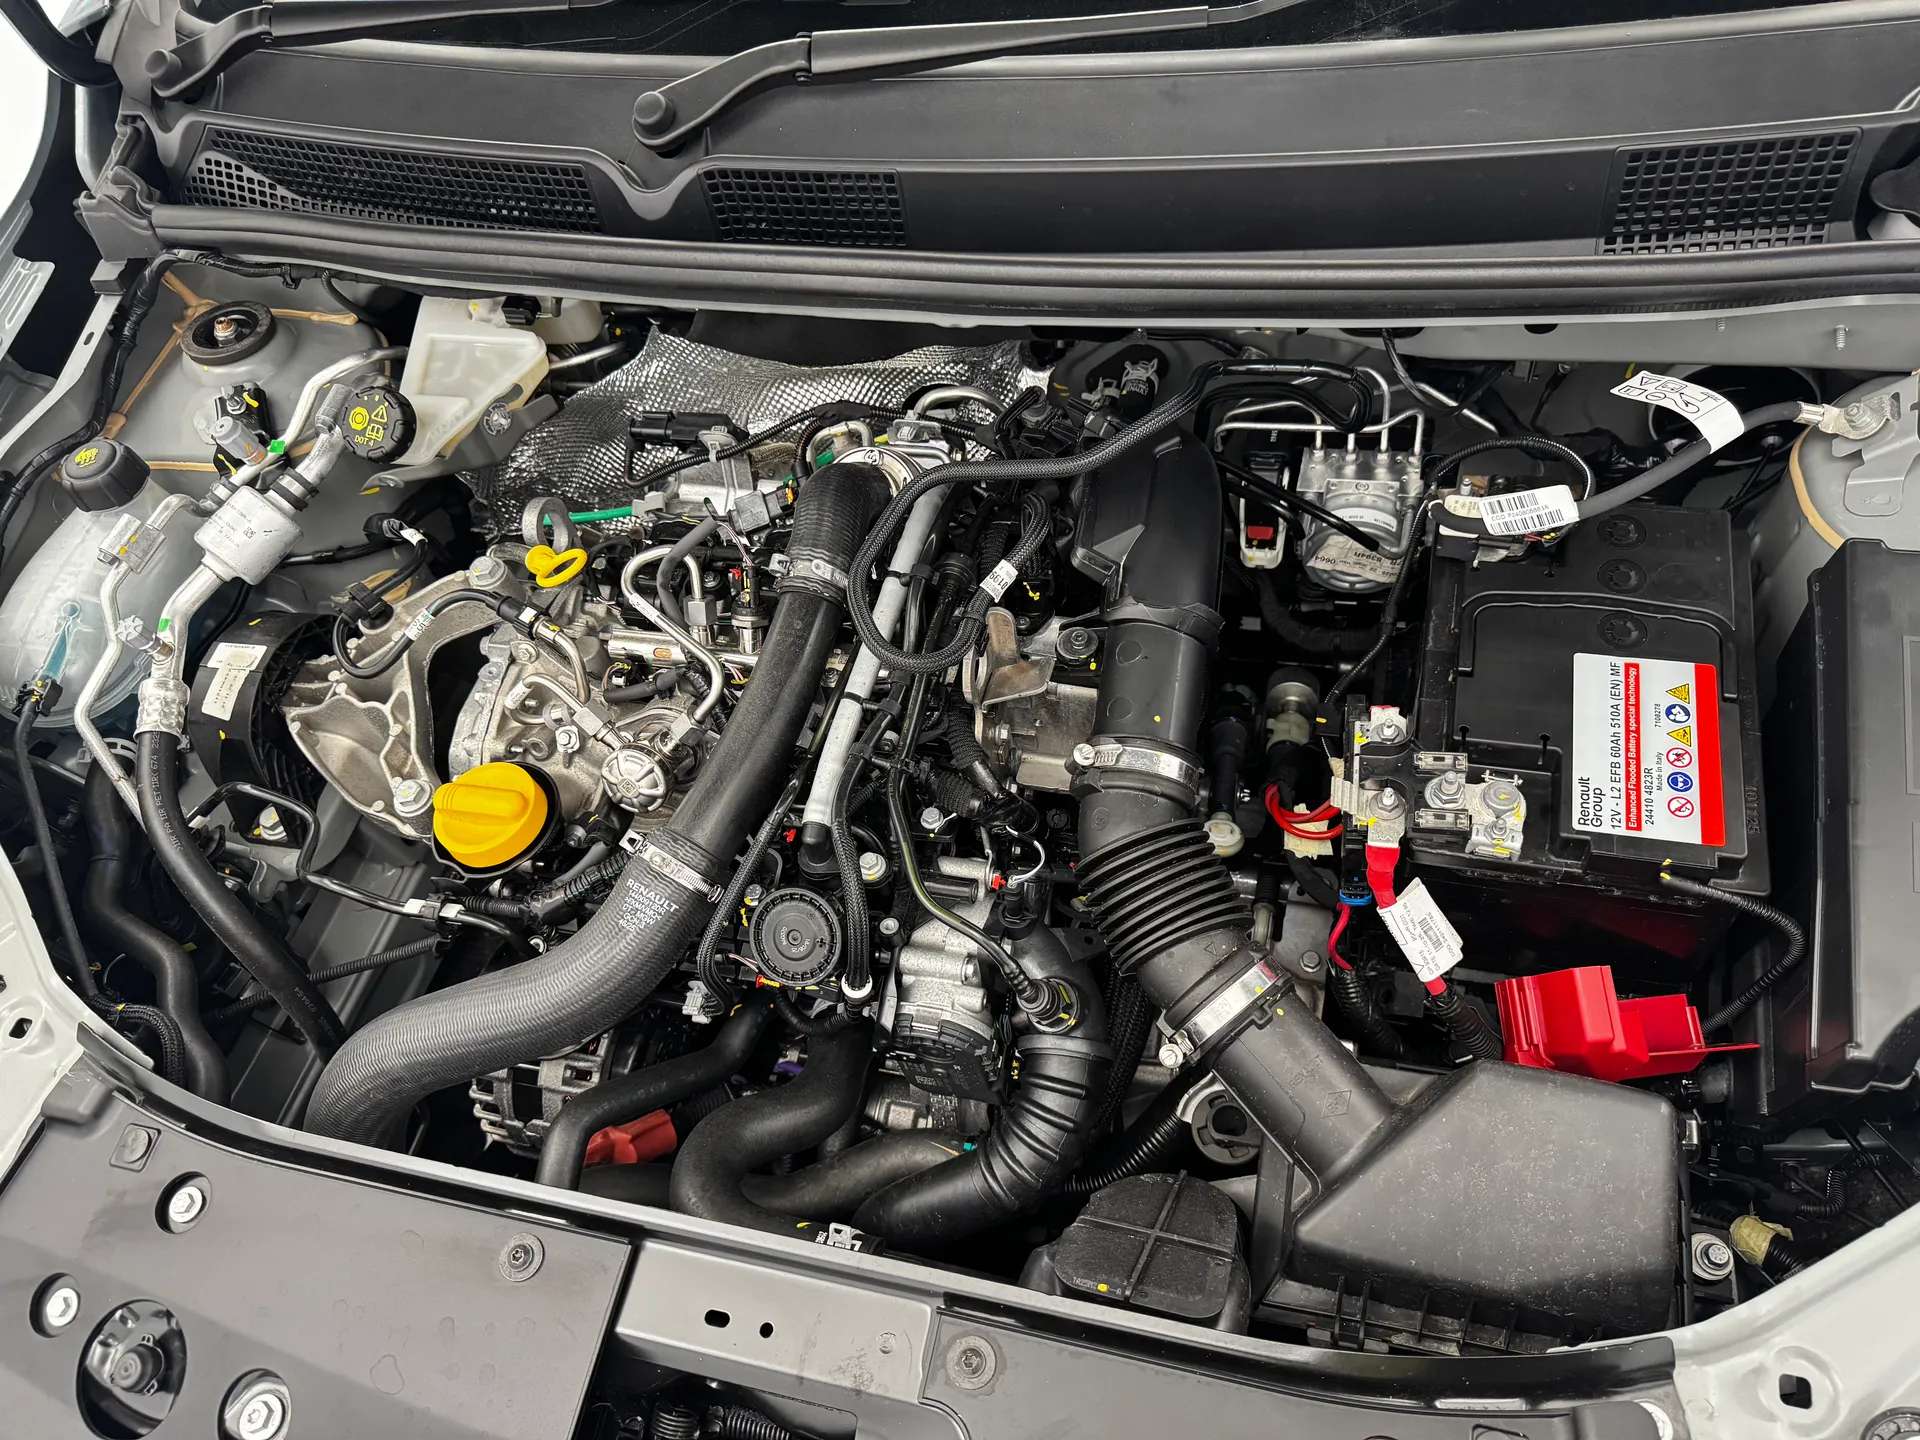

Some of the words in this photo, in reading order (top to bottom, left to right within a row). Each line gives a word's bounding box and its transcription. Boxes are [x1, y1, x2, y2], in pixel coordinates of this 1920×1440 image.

[354, 434, 368, 445] DOT
[1610, 661, 1621, 679] MF
[1610, 680, 1624, 702] (EN)
[1627, 667, 1639, 705] technology
[1610, 703, 1622, 728] 510A
[1628, 705, 1639, 731] special
[1610, 728, 1622, 759] 60Ah
[1627, 732, 1639, 758] Battery
[1655, 752, 1664, 766] Italy
[1610, 761, 1622, 784] EFB
[1627, 759, 1637, 790] Flooded
[1644, 767, 1654, 796] 4823R
[1656, 775, 1664, 791] Made
[154, 791, 162, 806] PET
[1578, 776, 1591, 826] Renault
[1610, 785, 1622, 800] L2
[1591, 787, 1606, 828] Group
[1610, 807, 1622, 830] 12V
[1628, 790, 1638, 828] Enhanced
[1645, 798, 1655, 826] 24410
[626, 879, 679, 912] RENAULT
